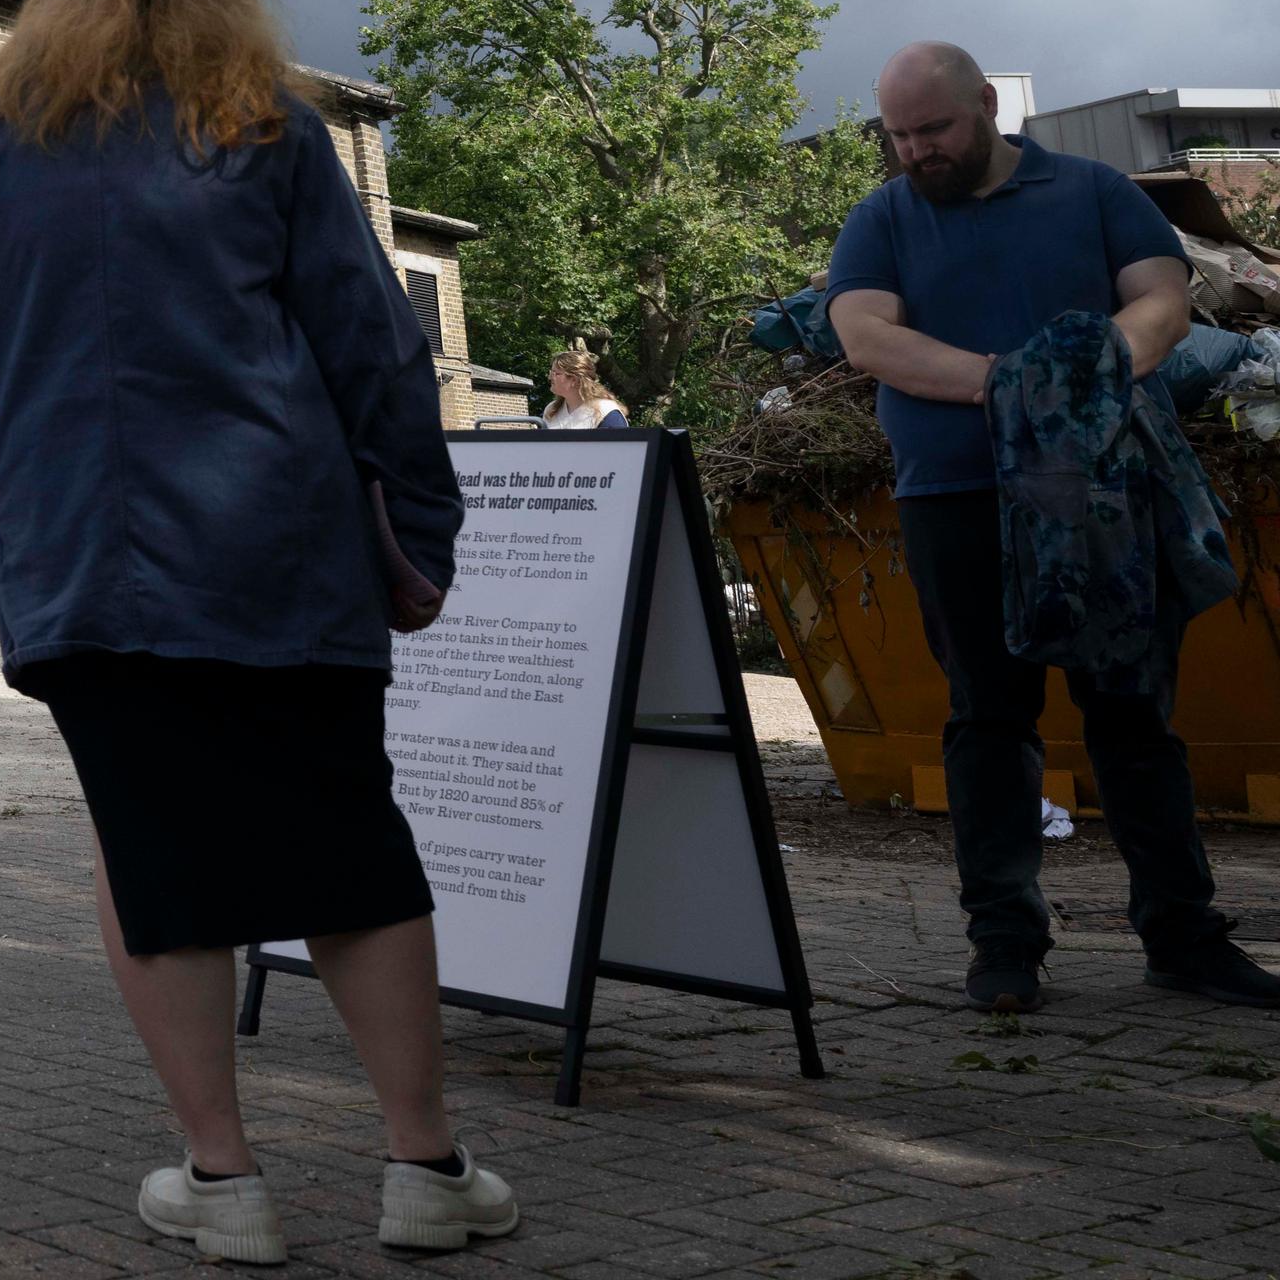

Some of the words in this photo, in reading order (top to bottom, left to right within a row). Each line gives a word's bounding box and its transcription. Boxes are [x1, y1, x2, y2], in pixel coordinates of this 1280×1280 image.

[484, 475, 506, 487] was
[509, 472, 530, 488] the
[532, 472, 555, 488] hub
[558, 472, 573, 488] of
[574, 476, 596, 489] one
[600, 472, 616, 489] of
[489, 494, 525, 510] water
[527, 495, 597, 514] companies.
[454, 533, 471, 542] ew
[474, 531, 508, 543] River
[510, 532, 549, 545] flowed
[552, 533, 582, 545] from
[454, 547, 477, 559] this
[479, 549, 503, 560] site.
[506, 549, 540, 561] From
[543, 551, 571, 562] here
[574, 551, 595, 563] the
[460, 564, 479, 576] the
[482, 566, 507, 579] City
[509, 566, 524, 578] of
[524, 567, 572, 580] London
[575, 569, 588, 580] in
[436, 614, 462, 625] New
[465, 616, 499, 628] River
[501, 618, 560, 634] Company
[563, 622, 577, 633] to
[411, 631, 442, 643] pipes
[445, 633, 457, 642] to
[459, 633, 493, 646] tanks
[496, 635, 509, 646] in
[511, 636, 543, 648] their
[545, 638, 589, 652] homes.
[401, 645, 411, 656] it
[413, 648, 434, 658] one
[436, 648, 450, 660] of
[450, 648, 470, 661] the
[472, 650, 505, 664] three
[508, 653, 575, 669] wealthiest
[400, 662, 412, 673] in
[414, 663, 491, 681] 17th-century
[493, 670, 545, 685] London,
[547, 674, 585, 689] along
[392, 680, 414, 691] ank
[416, 681, 430, 692] of
[430, 682, 482, 697] England
[484, 686, 507, 699] and
[510, 688, 531, 701] the
[534, 690, 565, 704] East
[384, 729, 399, 741] or
[400, 733, 435, 745] water
[437, 737, 461, 748] was
[462, 740, 470, 749] a
[473, 740, 499, 751] new
[501, 741, 528, 755] idea
[530, 745, 556, 758] and
[386, 749, 417, 761] ested
[420, 751, 454, 765] about
[457, 754, 469, 766] it.
[472, 756, 504, 772] They
[505, 760, 533, 774] said
[535, 763, 563, 777] that
[396, 768, 450, 782] essential
[452, 773, 495, 787] should
[497, 778, 519, 790] not
[521, 779, 536, 792] be
[398, 783, 421, 796] But
[423, 785, 438, 800] by
[439, 788, 469, 802] 1820
[472, 793, 517, 808] around
[520, 798, 546, 813] 85%
[548, 801, 564, 814] of
[408, 802, 436, 816] New
[437, 805, 473, 821] River
[474, 812, 544, 830] customers.
[420, 840, 434, 852] of
[433, 842, 467, 857] pipes
[469, 848, 505, 865] carry
[507, 853, 546, 868] water
[462, 866, 485, 878] you
[487, 870, 511, 883] can
[513, 871, 545, 887] hear
[467, 883, 498, 899] from
[500, 888, 527, 903] this
